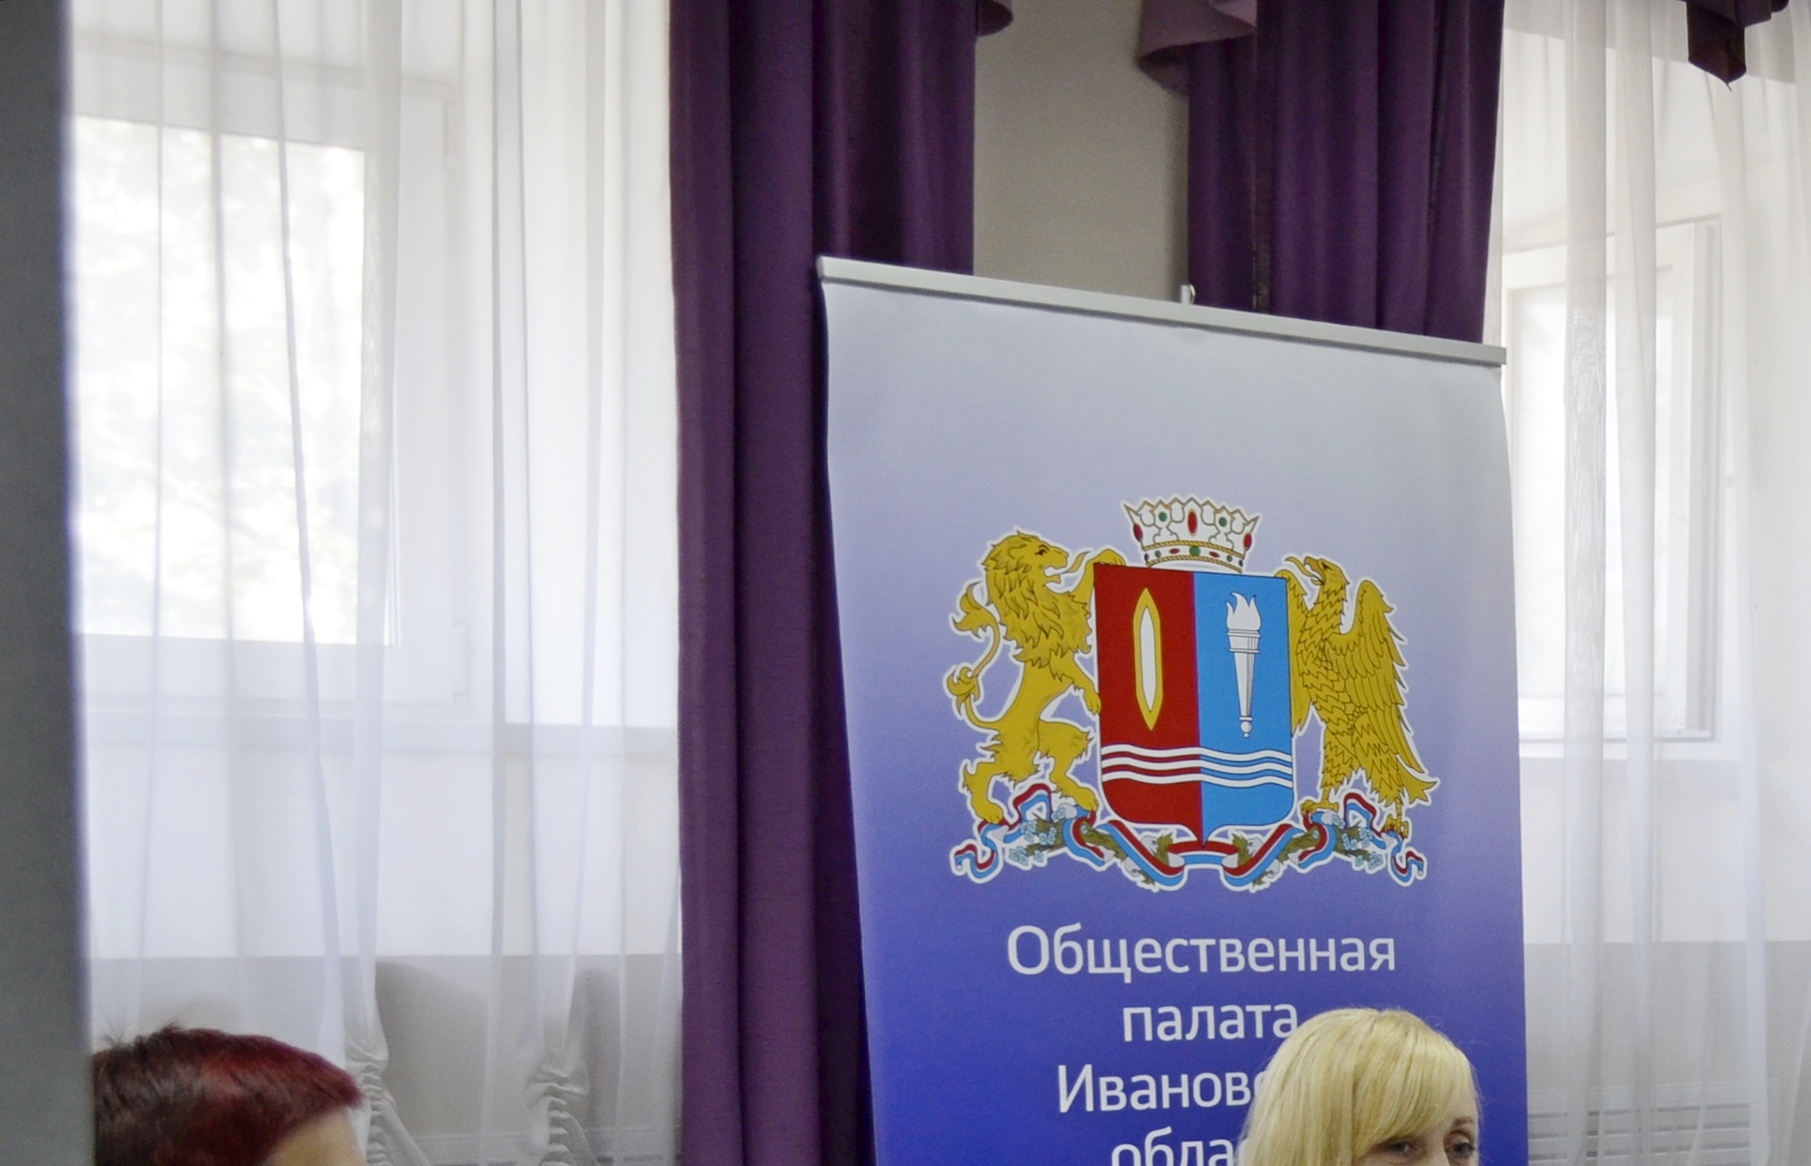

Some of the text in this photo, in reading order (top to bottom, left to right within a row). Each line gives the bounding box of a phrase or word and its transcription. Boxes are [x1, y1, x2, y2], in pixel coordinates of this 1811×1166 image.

[1007, 924, 1396, 983] Общественная
[1123, 1004, 1298, 1041] палата
[1058, 1064, 1267, 1113] Иванов
